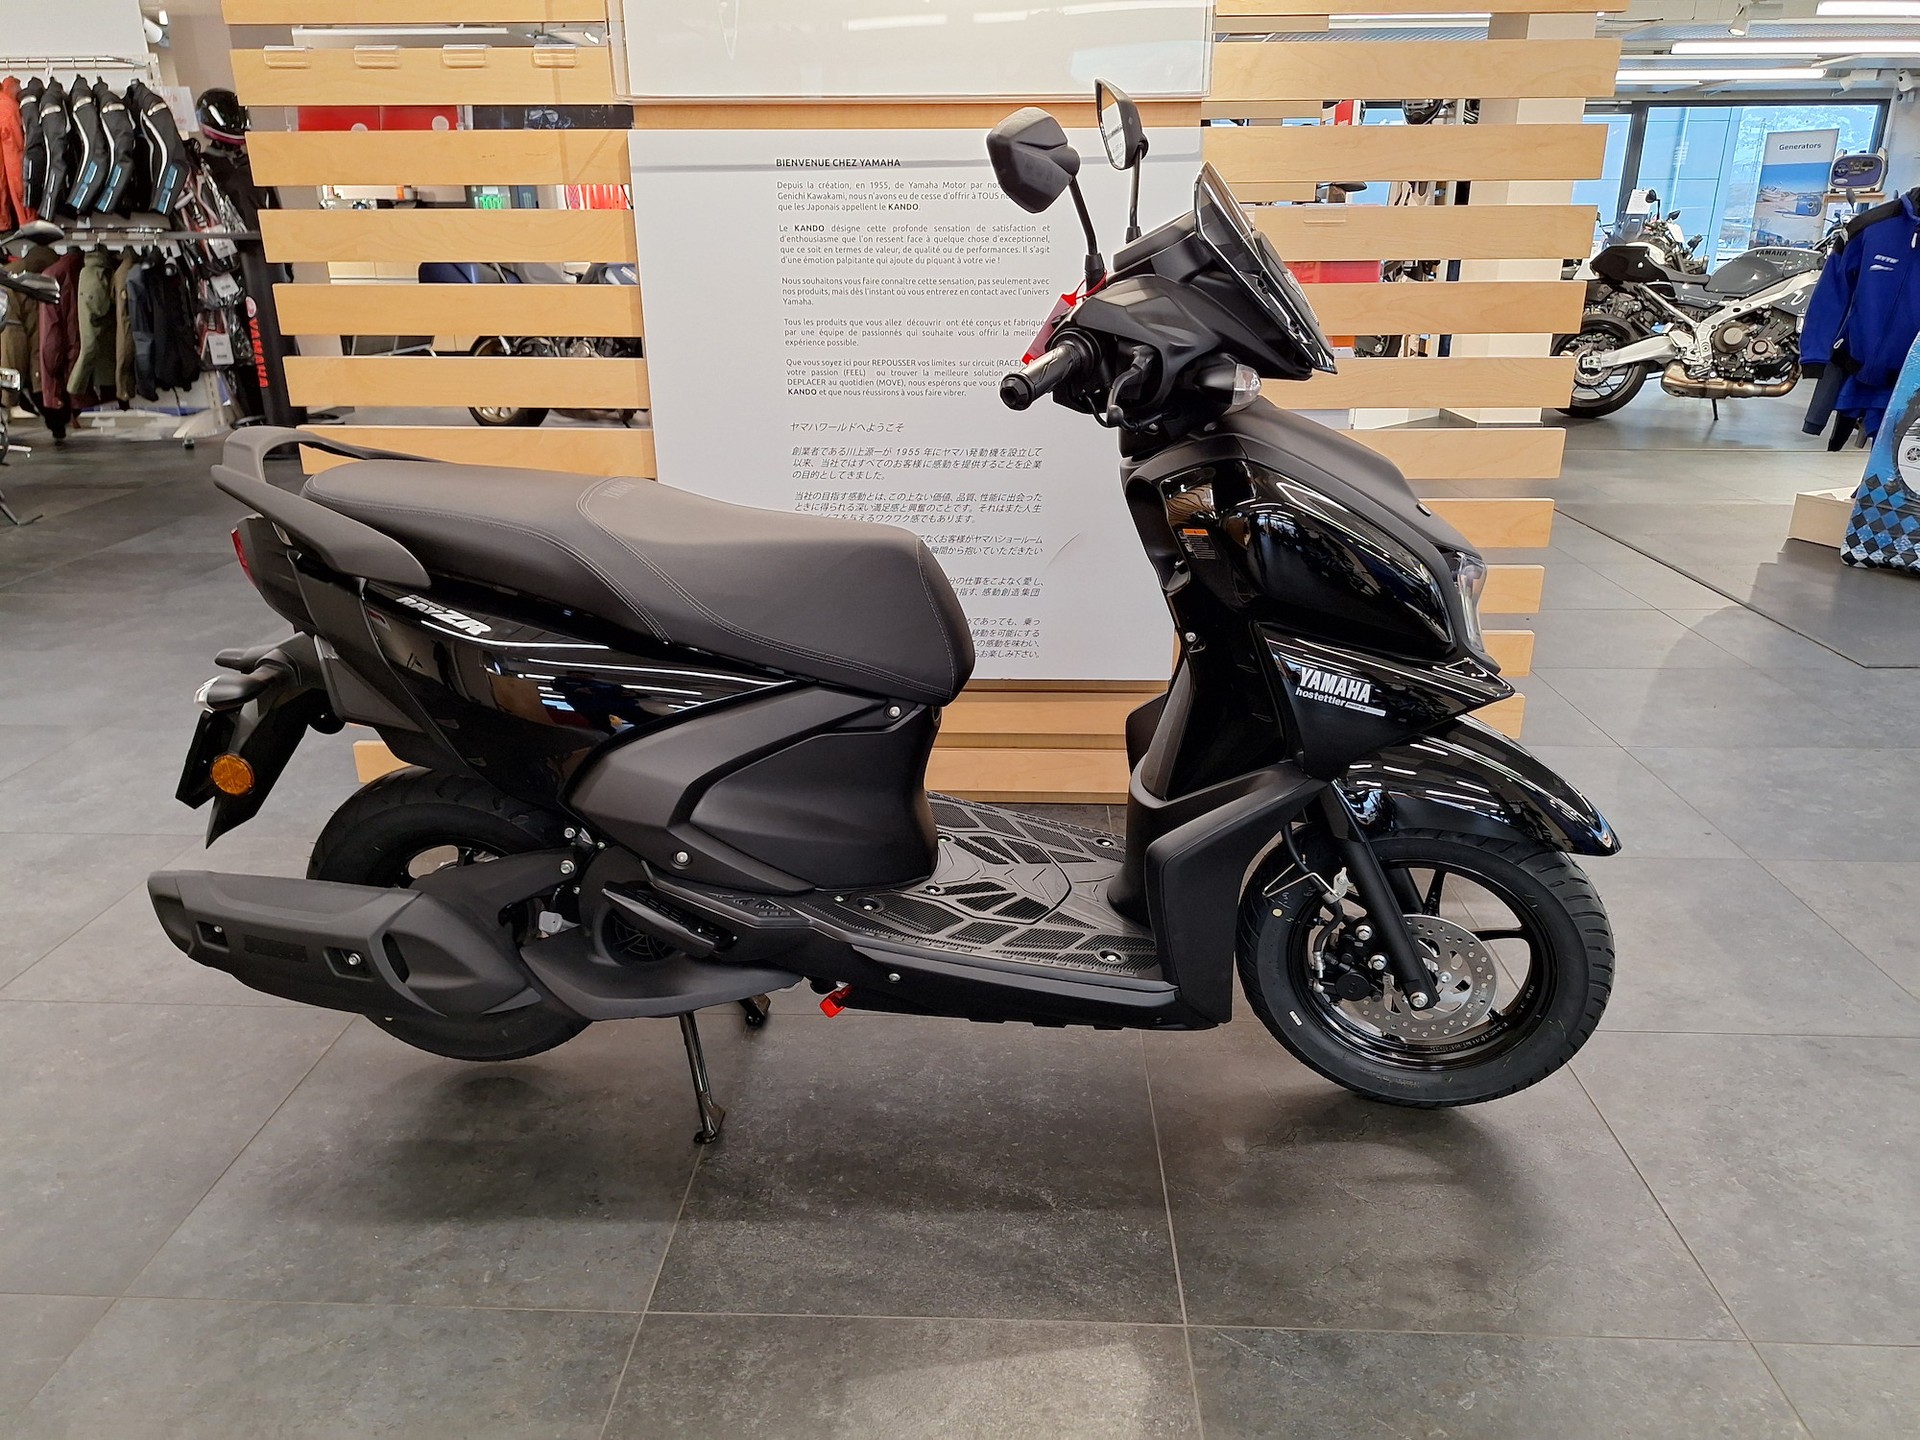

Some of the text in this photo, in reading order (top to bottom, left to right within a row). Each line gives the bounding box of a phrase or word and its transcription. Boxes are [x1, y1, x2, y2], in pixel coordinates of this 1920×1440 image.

[1778, 142, 1822, 151] Generators
[776, 158, 901, 167] BIENVENUE CHEZ YAMAHA
[776, 180, 983, 191] Depuis création, 1955, de Yamaha Motor par
[777, 191, 806, 200] Genichi
[806, 191, 848, 202] Kawakami,
[868, 191, 897, 200] n'avons
[909, 191, 919, 200] de
[942, 191, 970, 200] d'offrir
[977, 191, 999, 200] TOUS
[777, 202, 921, 213] que les Japonais appellent KANDO.
[794, 224, 1037, 235] KANDO désigne cette profonde sensation de satisfaction
[779, 234, 1050, 245] d'enthousiasme que l'on ressent face quelque chose d'exceptionnel,
[779, 245, 1050, 256] que soit termes de valeur, qualité de performances. s'agit
[1755, 249, 1788, 257] YAMAHA
[780, 255, 996, 266] d'une émotion palpitante qui ajoute du piquant votre vie
[781, 276, 802, 285] Nous
[802, 276, 843, 285] souhaitons
[862, 276, 880, 285] faire
[880, 276, 917, 286] connaître
[917, 277, 937, 286] cette
[938, 276, 976, 287] sensation,
[977, 278, 991, 288] pas
[992, 276, 1032, 286] seulement
[797, 287, 831, 298] produits,
[831, 287, 849, 296] mais
[850, 287, 864, 296] dès
[864, 287, 895, 296] l'instant
[926, 287, 958, 296] entrerez
[970, 287, 998, 296] contact
[1018, 287, 1050, 296] l'univers
[782, 297, 814, 306] Yamaha.
[784, 318, 801, 327] Tous
[803, 318, 814, 327] les
[816, 318, 848, 329] produits
[849, 320, 863, 329] que
[884, 318, 902, 327] allez
[906, 318, 941, 327] découvrir
[946, 318, 959, 327] ont
[961, 318, 974, 327] été
[975, 320, 1001, 329] conçus
[784, 329, 796, 339] par
[819, 328, 845, 339] équipe
[861, 328, 903, 339] passionnés
[906, 328, 918, 339] qui
[921, 328, 954, 337] souhaite
[978, 328, 999, 337] offrir
[784, 338, 859, 349] expérience possible.
[786, 358, 802, 368] Que
[821, 360, 842, 369] soyez
[853, 360, 871, 369] pour
[871, 358, 916, 367] REPOUSSER
[931, 358, 956, 367] limites
[972, 358, 995, 367] circuit
[996, 358, 1024, 369] (RACE),
[786, 368, 807, 377] votre
[811, 368, 839, 379] passion
[843, 368, 866, 378] (FEEL)
[890, 368, 918, 377] trouver
[934, 368, 969, 377] meilleure
[973, 368, 1004, 377] solution
[787, 378, 826, 387] DEPLACER
[839, 378, 874, 389] quotidien
[875, 378, 906, 388] (MOVE),
[927, 378, 961, 389] espérons
[963, 380, 977, 389] que
[787, 387, 817, 396] KANDO
[827, 389, 842, 398] que
[862, 387, 900, 396] réussirons
[924, 388, 942, 397] faire
[943, 388, 967, 397] vibrer.
[790, 422, 905, 433] ヤマハワールドへようこそ
[896, 447, 920, 456] 1955
[792, 470, 885, 480] の目的としてきました。
[1299, 666, 1371, 704] YAMAHA
[1295, 687, 1346, 707] hostettler
